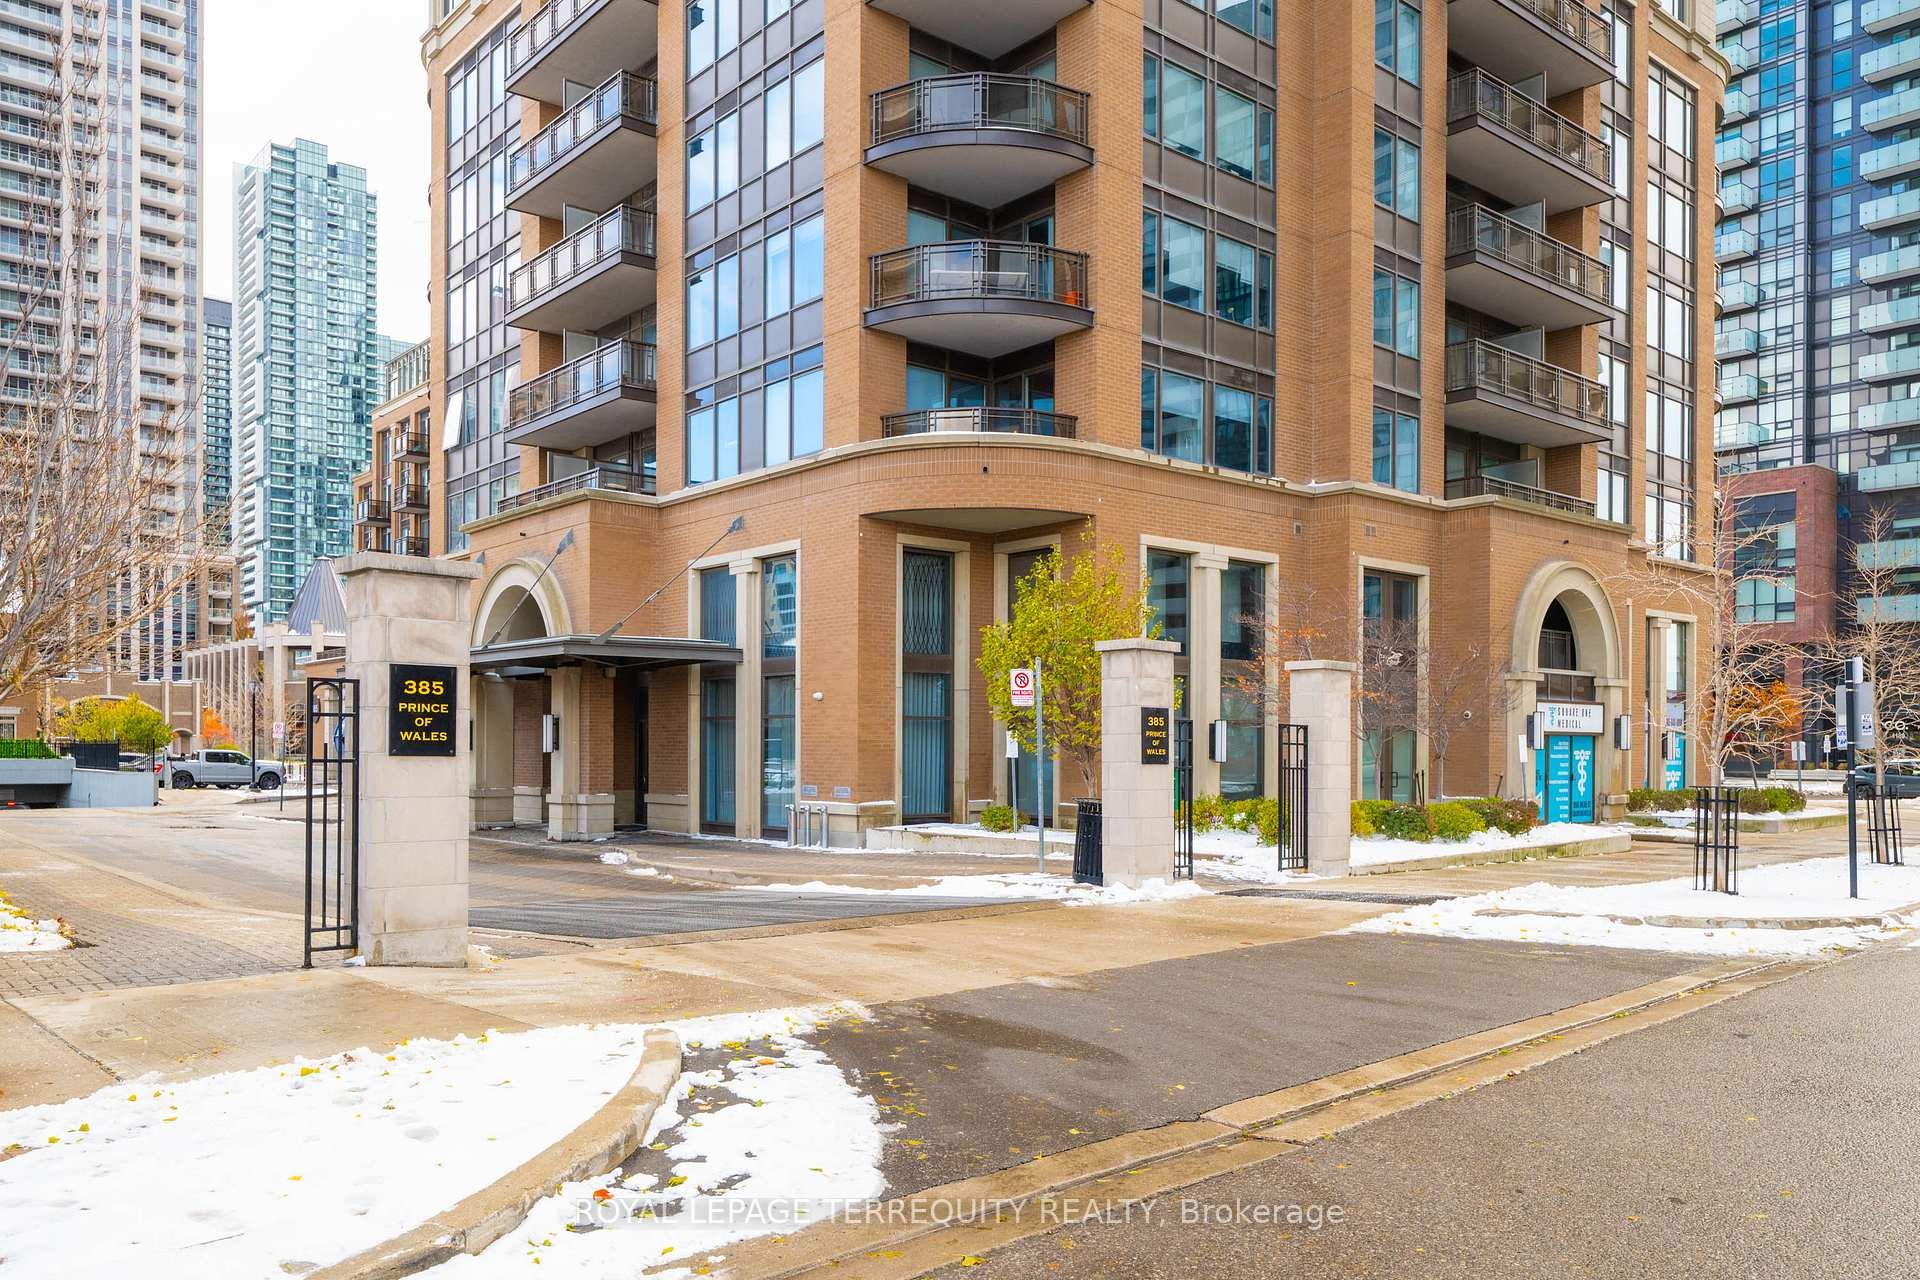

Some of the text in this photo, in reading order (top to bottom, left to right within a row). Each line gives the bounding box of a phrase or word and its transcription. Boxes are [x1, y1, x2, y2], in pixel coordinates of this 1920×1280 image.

[404, 680, 444, 695] 385
[399, 702, 449, 713] PRINCE
[414, 717, 433, 727] OF
[1147, 716, 1165, 726] 385
[1557, 719, 1581, 728] MEDICAL
[400, 731, 448, 741] WALES
[1145, 730, 1167, 738] PRINCE
[1146, 748, 1166, 756] WALES
